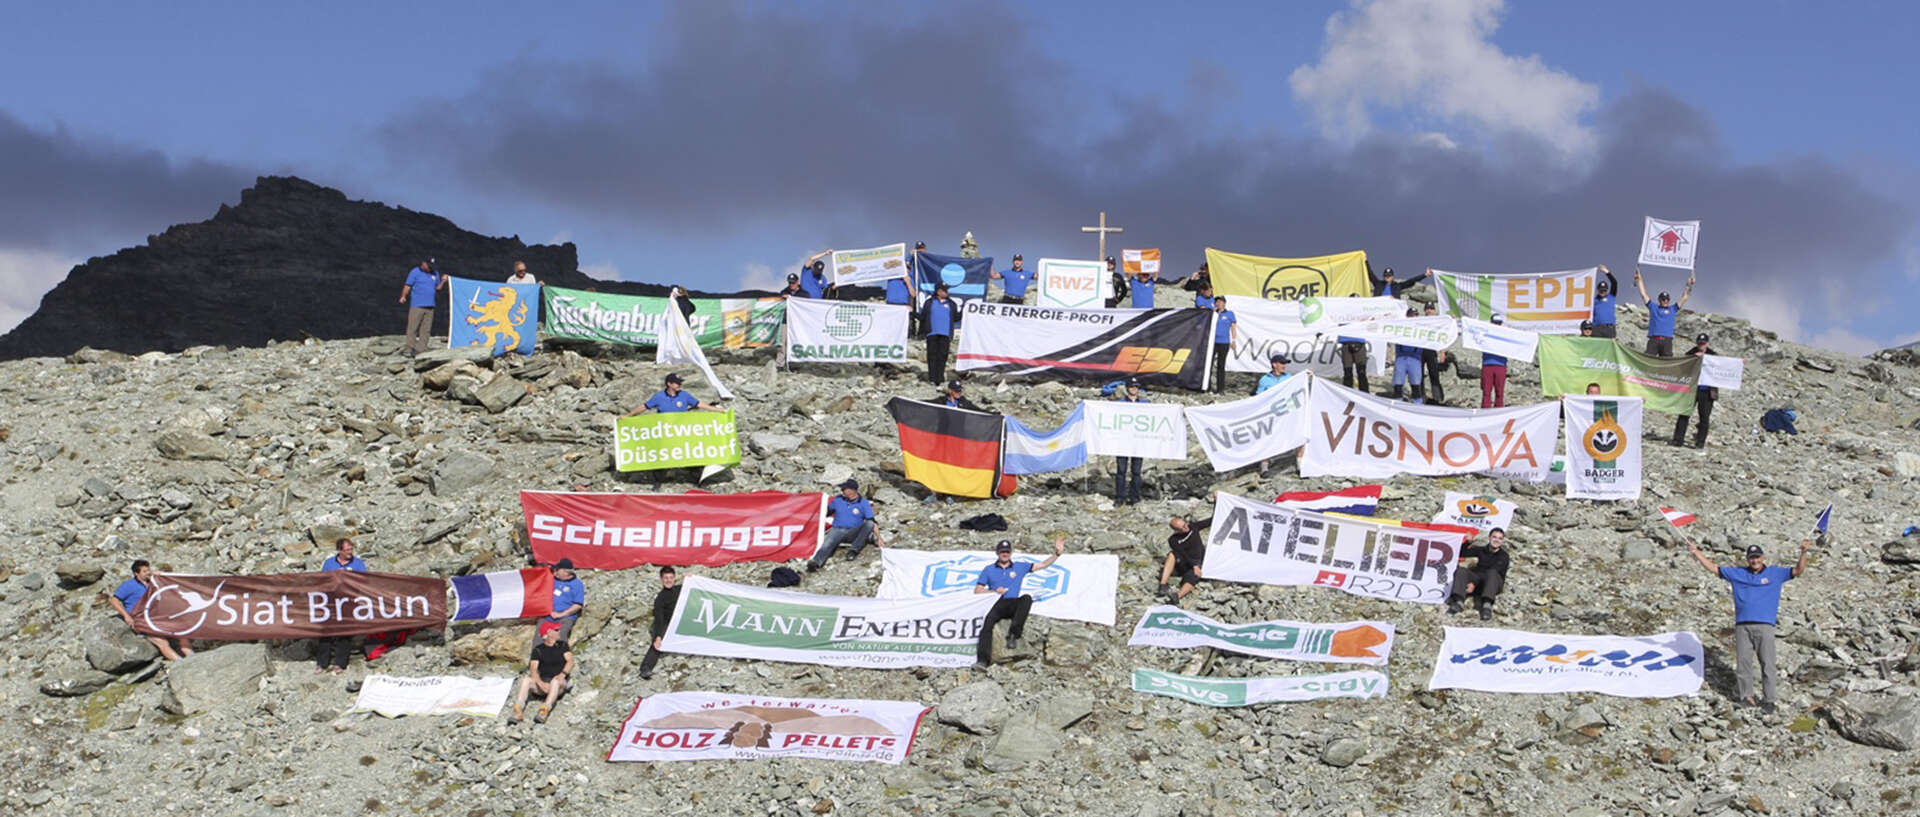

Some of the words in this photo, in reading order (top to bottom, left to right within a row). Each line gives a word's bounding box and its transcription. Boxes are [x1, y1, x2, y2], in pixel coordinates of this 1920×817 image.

[1048, 274, 1095, 292] RWZ
[1264, 281, 1321, 301] GRAF
[1506, 276, 1593, 310] EPH
[967, 303, 996, 317] DER
[1001, 305, 1115, 326] ENERGIE-PROFI
[1382, 325, 1449, 344] PFEIFER
[790, 343, 905, 361] SALMATEC
[620, 419, 735, 443] Stadtwerke
[1098, 412, 1175, 435] LIPSIA
[1320, 400, 1539, 469] VISNOVA
[620, 438, 738, 466] Düsseldorf
[1584, 468, 1625, 478] BADGER
[532, 513, 805, 552] Schellinger
[1213, 506, 1454, 585] ATELIER
[217, 593, 295, 627] Siat
[308, 591, 431, 624] Braun
[692, 597, 825, 638] MANN
[832, 642, 856, 650] VON
[858, 643, 890, 651] NATUR
[632, 730, 716, 749] HOLZ
